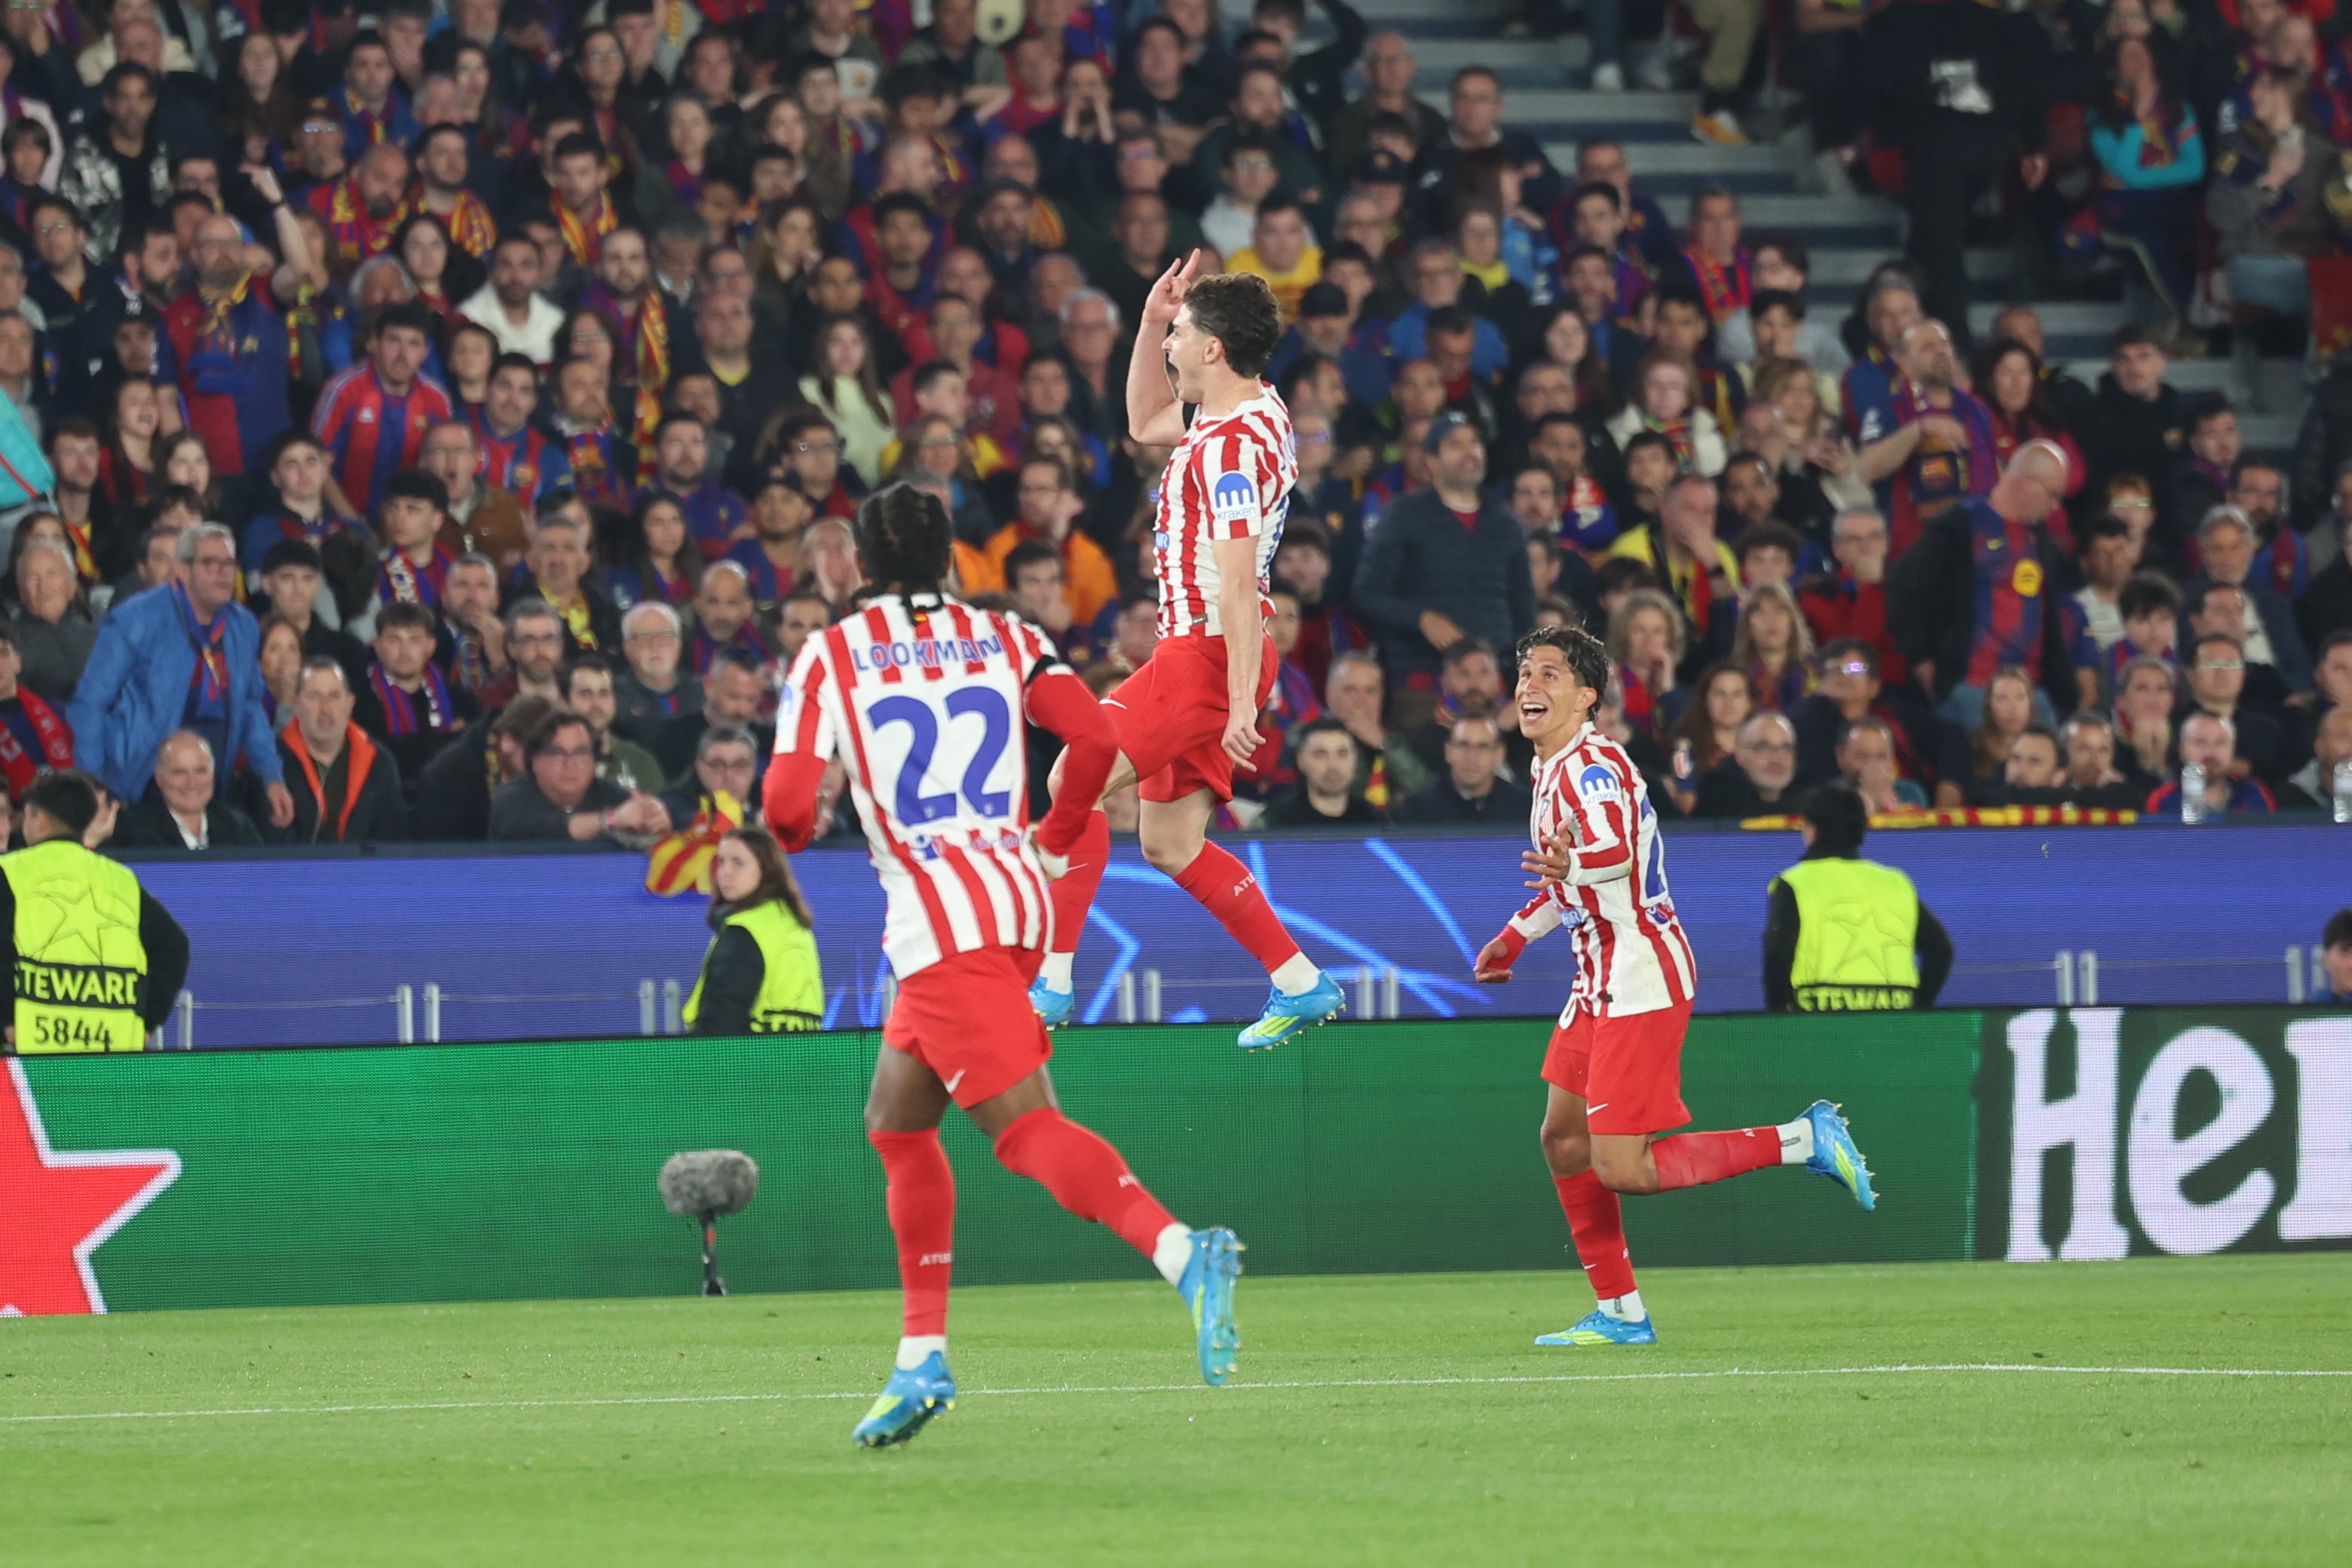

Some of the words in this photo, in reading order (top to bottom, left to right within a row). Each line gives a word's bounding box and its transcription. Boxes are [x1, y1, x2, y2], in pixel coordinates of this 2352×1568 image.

[1217, 507, 1256, 520] kraken
[853, 635, 1003, 671] LOOKMAN
[867, 686, 1010, 828] 22
[35, 1014, 112, 1050] 5844
